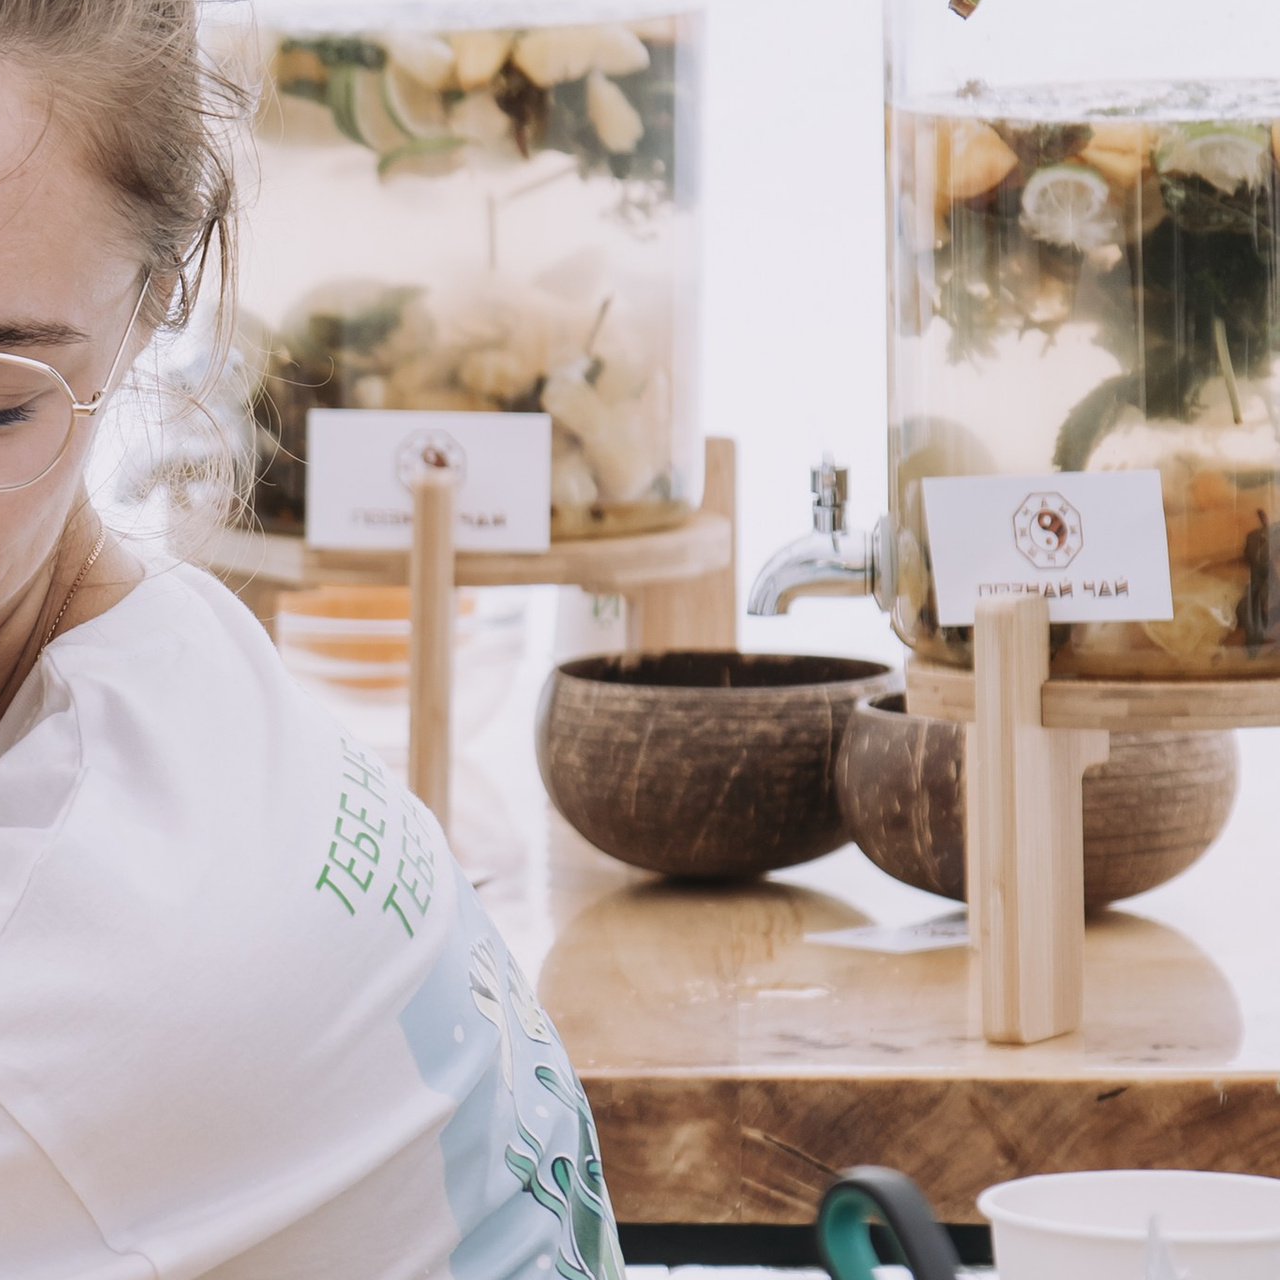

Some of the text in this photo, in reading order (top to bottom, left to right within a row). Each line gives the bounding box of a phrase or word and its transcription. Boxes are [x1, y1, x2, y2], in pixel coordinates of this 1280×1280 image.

[1082, 576, 1129, 599] ЧАЙ
[315, 791, 386, 917] ТЕБЕ
[382, 814, 434, 939] ТЕБЕ
